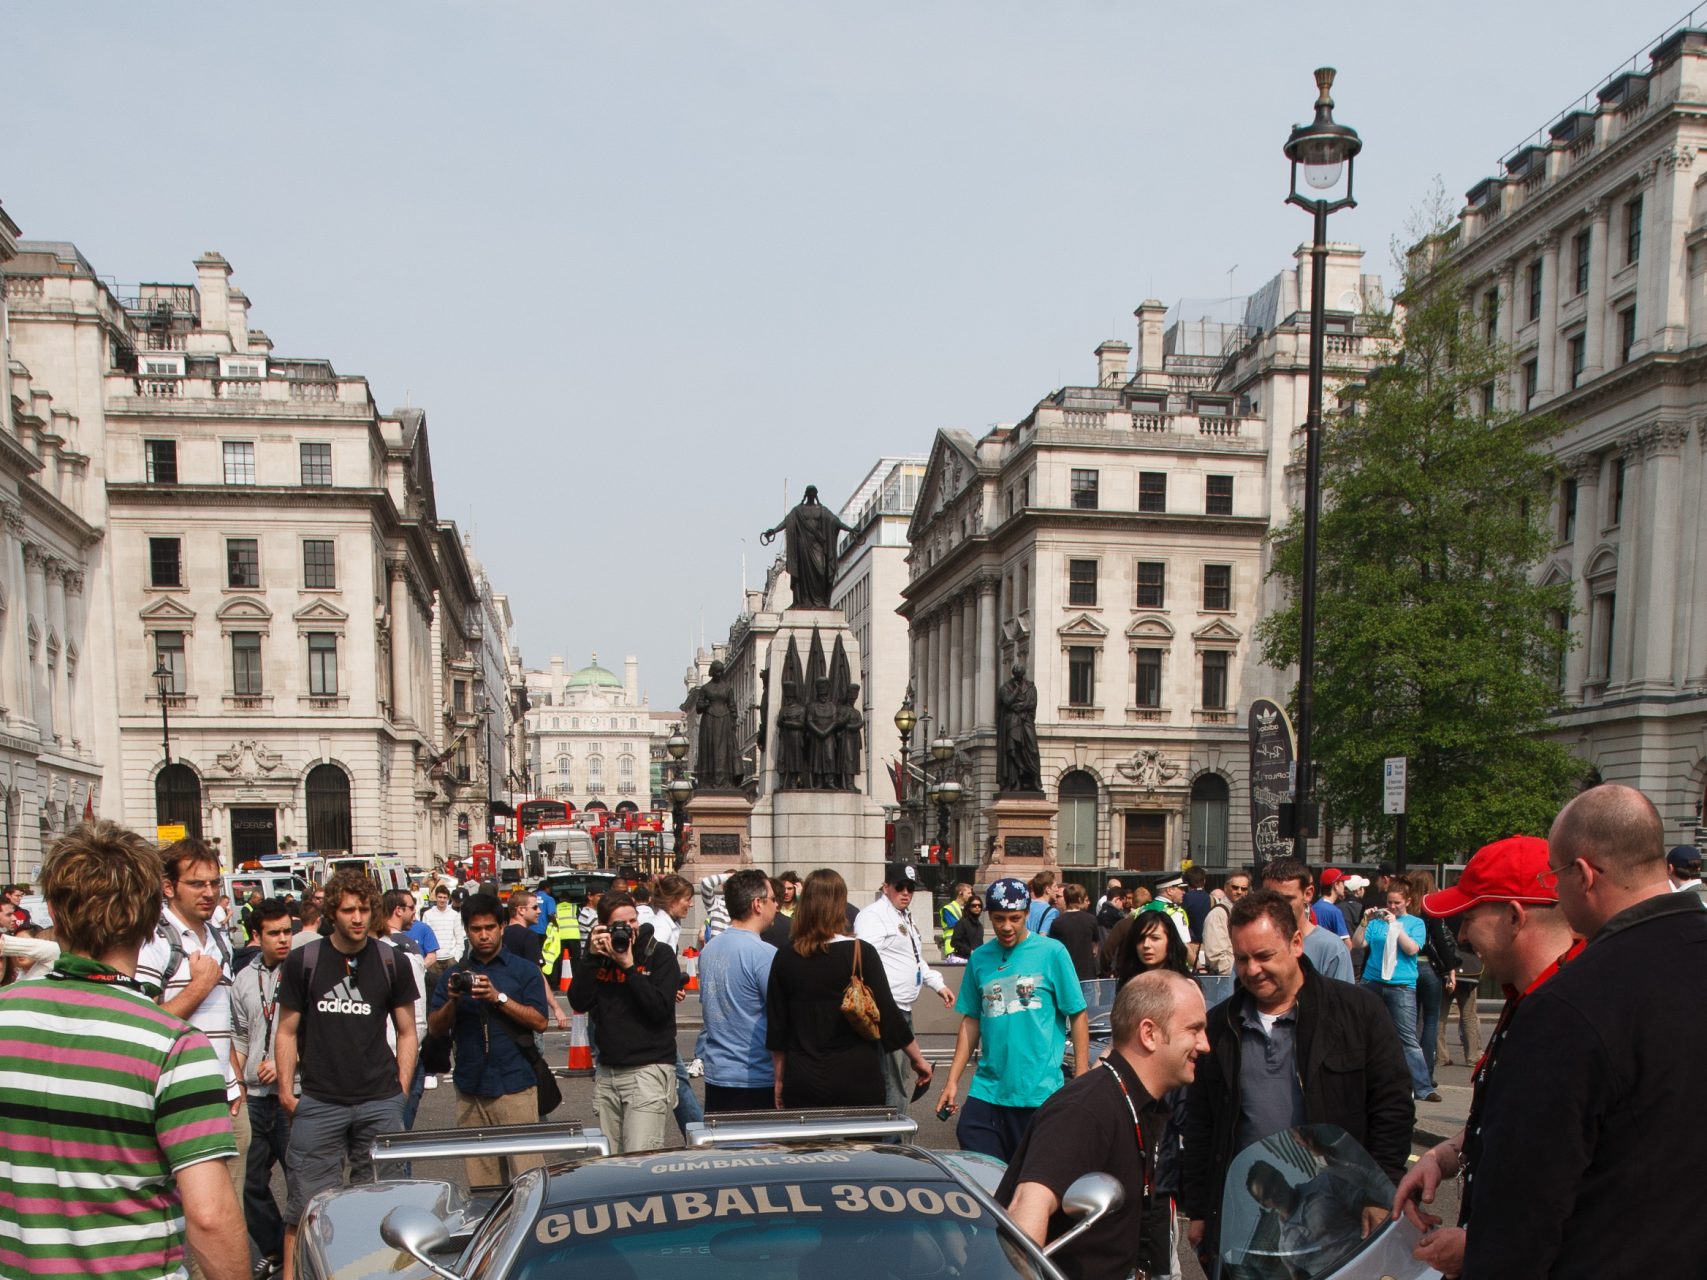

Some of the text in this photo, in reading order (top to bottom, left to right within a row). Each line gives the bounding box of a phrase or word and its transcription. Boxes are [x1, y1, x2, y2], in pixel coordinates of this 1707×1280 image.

[317, 998, 371, 1015] adidas
[650, 1154, 850, 1174] GUMBALL 3000
[536, 1184, 982, 1244] GUMBALL 3000
